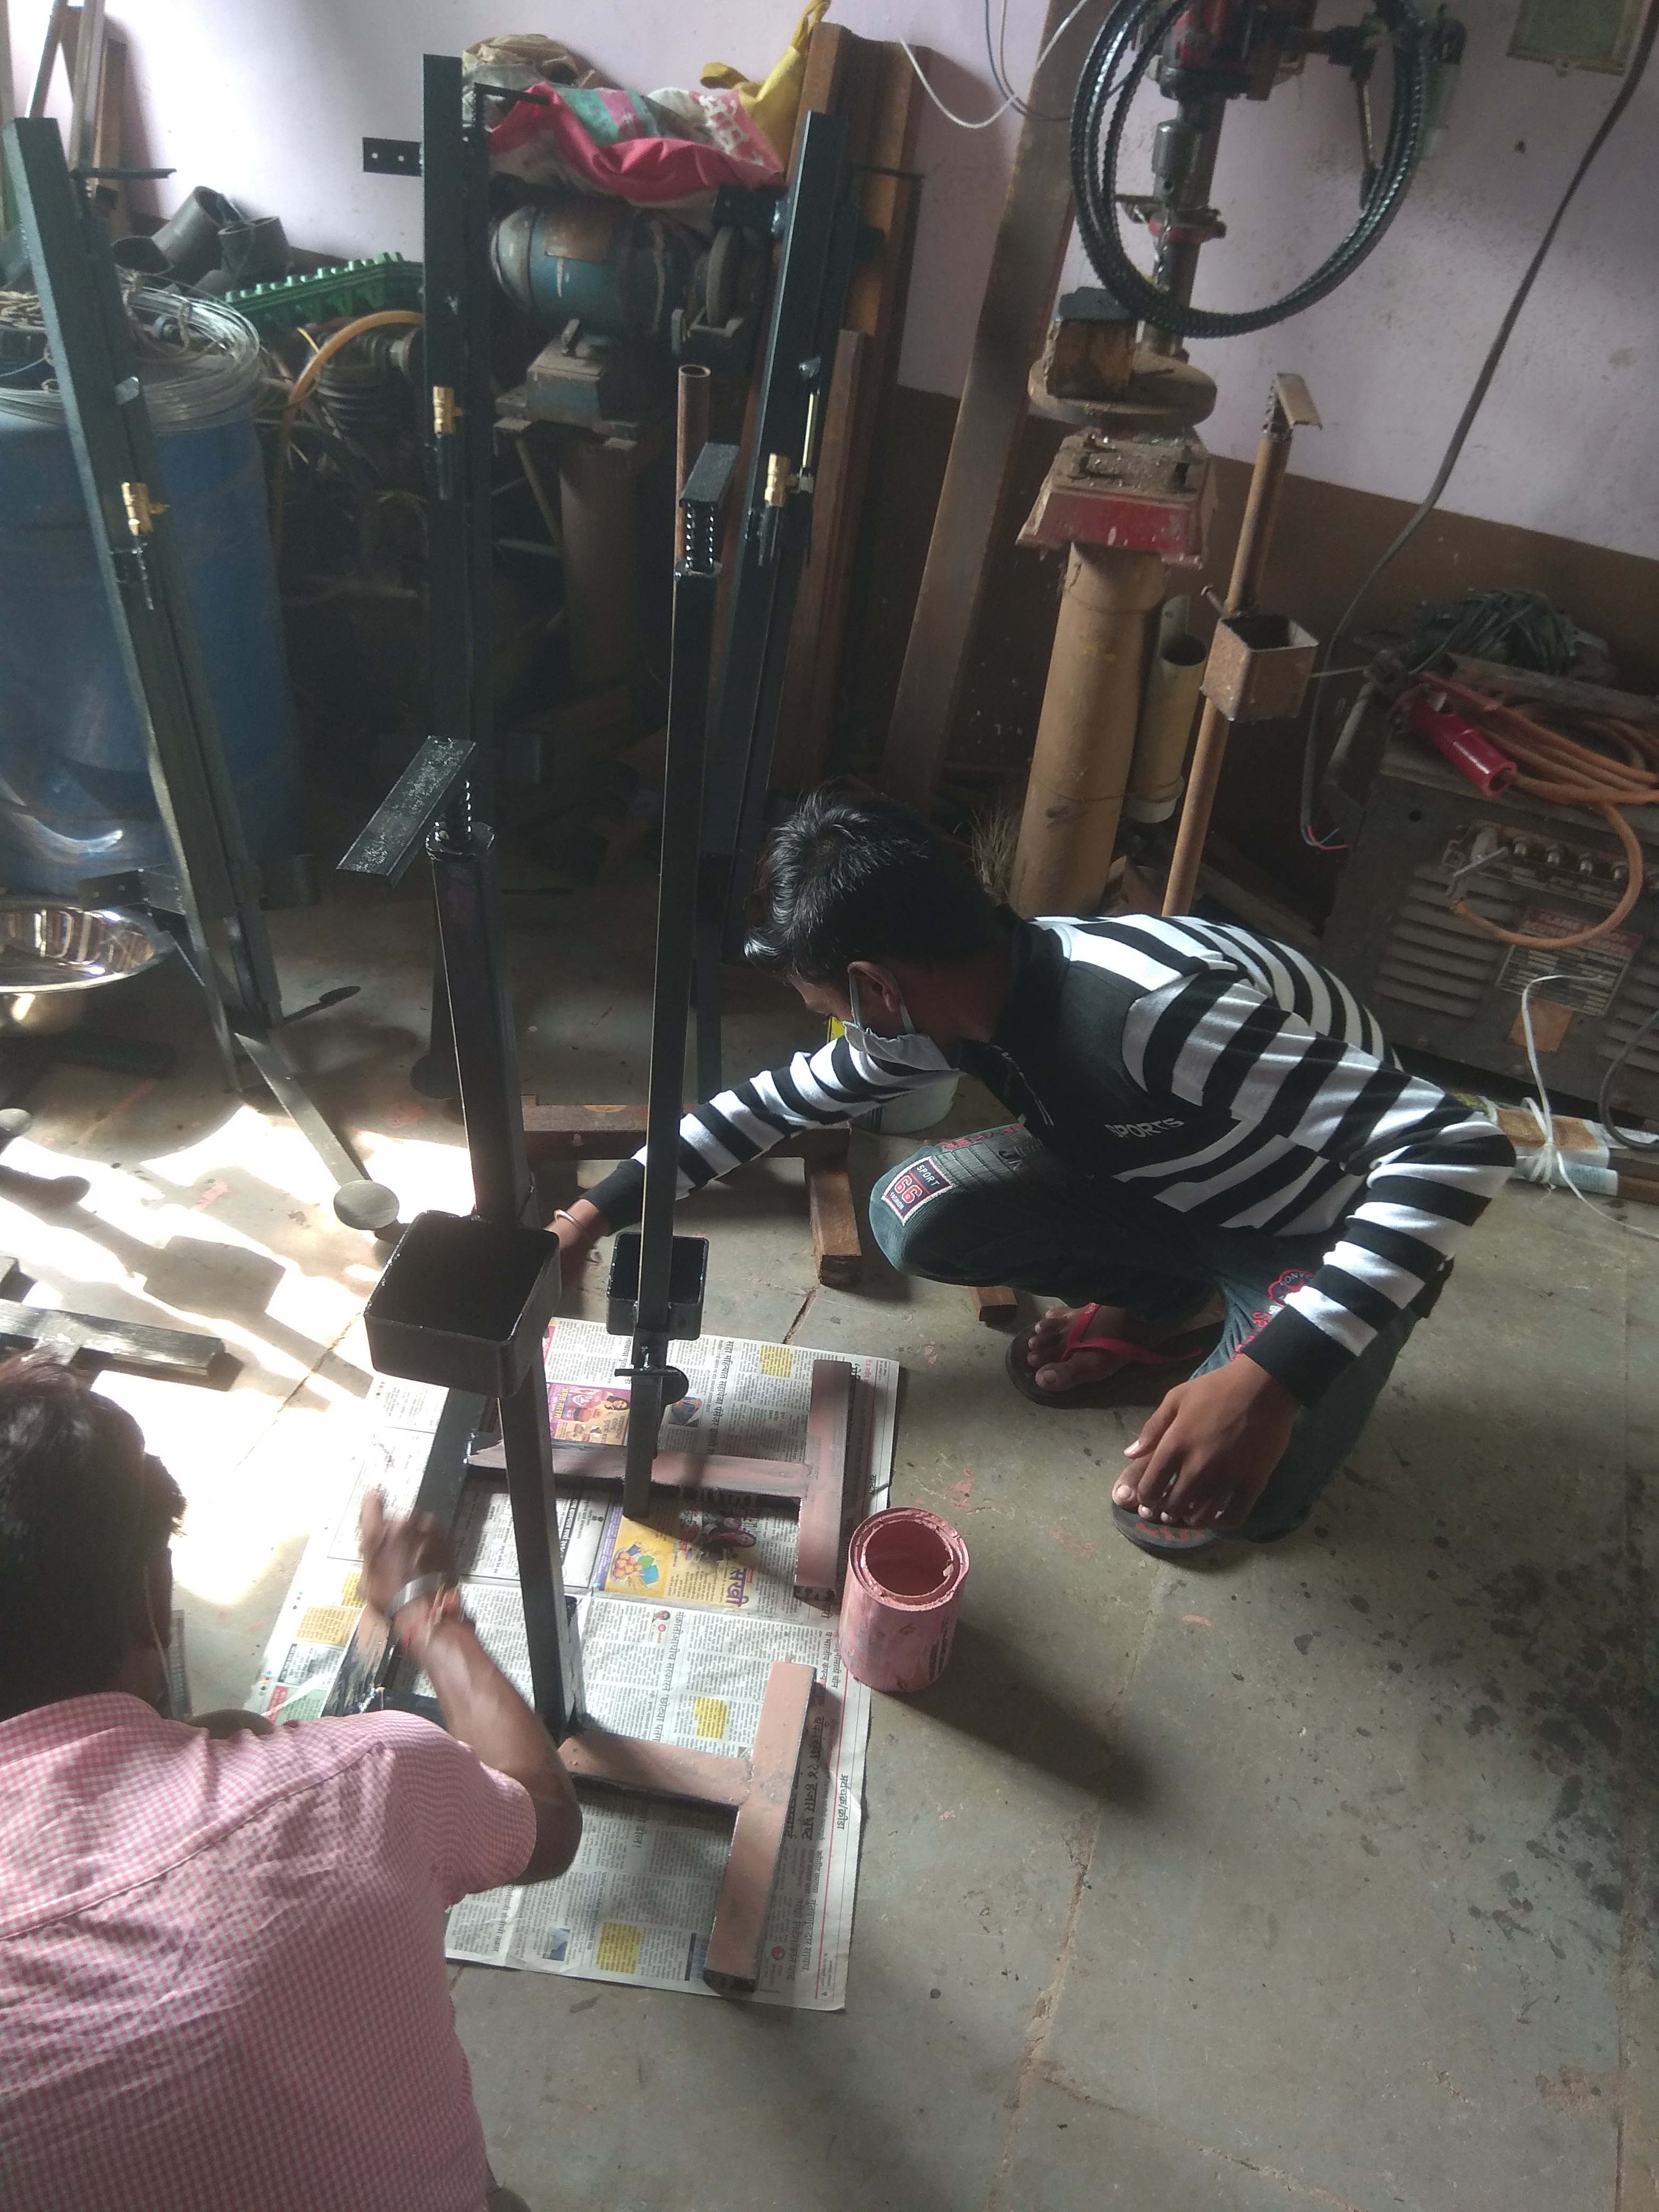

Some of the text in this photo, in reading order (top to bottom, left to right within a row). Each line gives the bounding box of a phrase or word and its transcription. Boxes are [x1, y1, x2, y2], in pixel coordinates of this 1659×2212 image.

[1104, 1118, 1184, 1138] SPORTS
[917, 1164, 940, 1187] SPORT
[890, 1191, 905, 1211] FASHION
[894, 1174, 924, 1204] 66
[724, 1340, 734, 1353] सहा
[719, 1354, 733, 1379] महिन्यात
[715, 1380, 728, 1405] सहावेळा
[725, 1567, 752, 1607] सखी
[823, 1638, 832, 1660] भारतीय
[661, 1662, 675, 1692] सरकारने
[820, 1662, 830, 1680] कंपन्य
[831, 1675, 841, 1688] चीन
[801, 1782, 818, 1813] हजार
[835, 1774, 851, 1830] अर्थचक्र/क्रीडा
